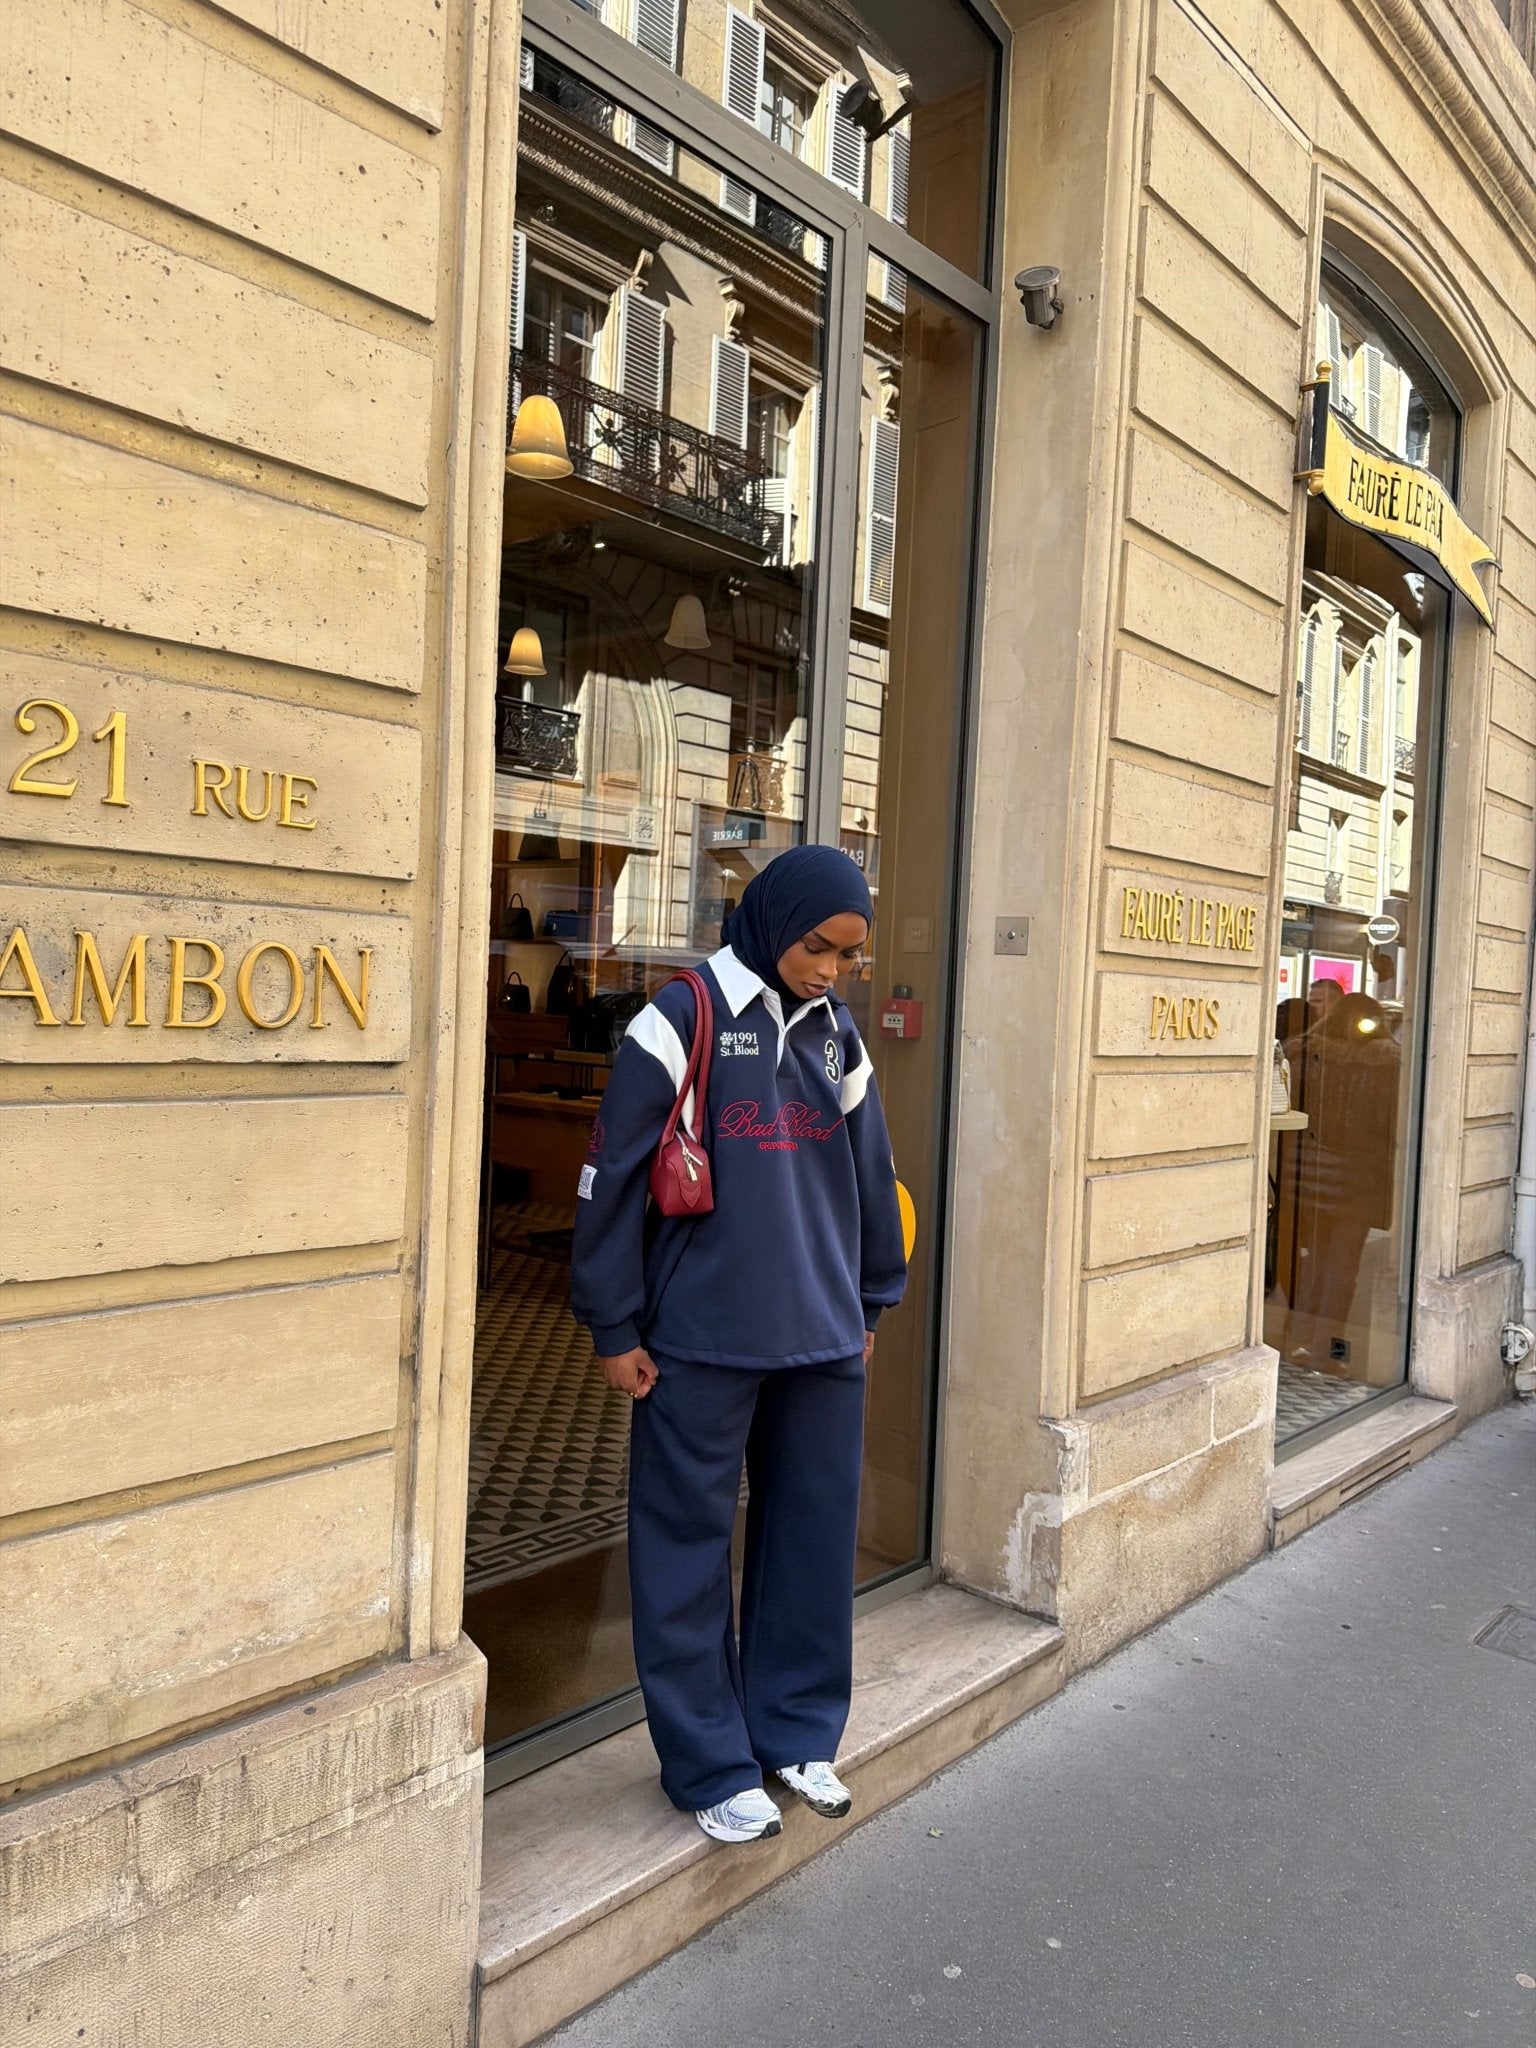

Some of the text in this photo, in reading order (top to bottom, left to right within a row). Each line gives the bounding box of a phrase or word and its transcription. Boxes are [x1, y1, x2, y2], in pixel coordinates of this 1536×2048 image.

[1405, 482, 1423, 527] LE
[7, 698, 319, 831] 21 RUE
[1188, 898, 1213, 946] LE
[1215, 902, 1257, 951] PAGE
[0, 926, 374, 1030] AMBON
[733, 1032, 758, 1045] 1991
[1150, 995, 1220, 1040] PARIS
[735, 1044, 759, 1056] Blood
[825, 1039, 840, 1084] 3
[718, 1100, 845, 1140] Bad Blood
